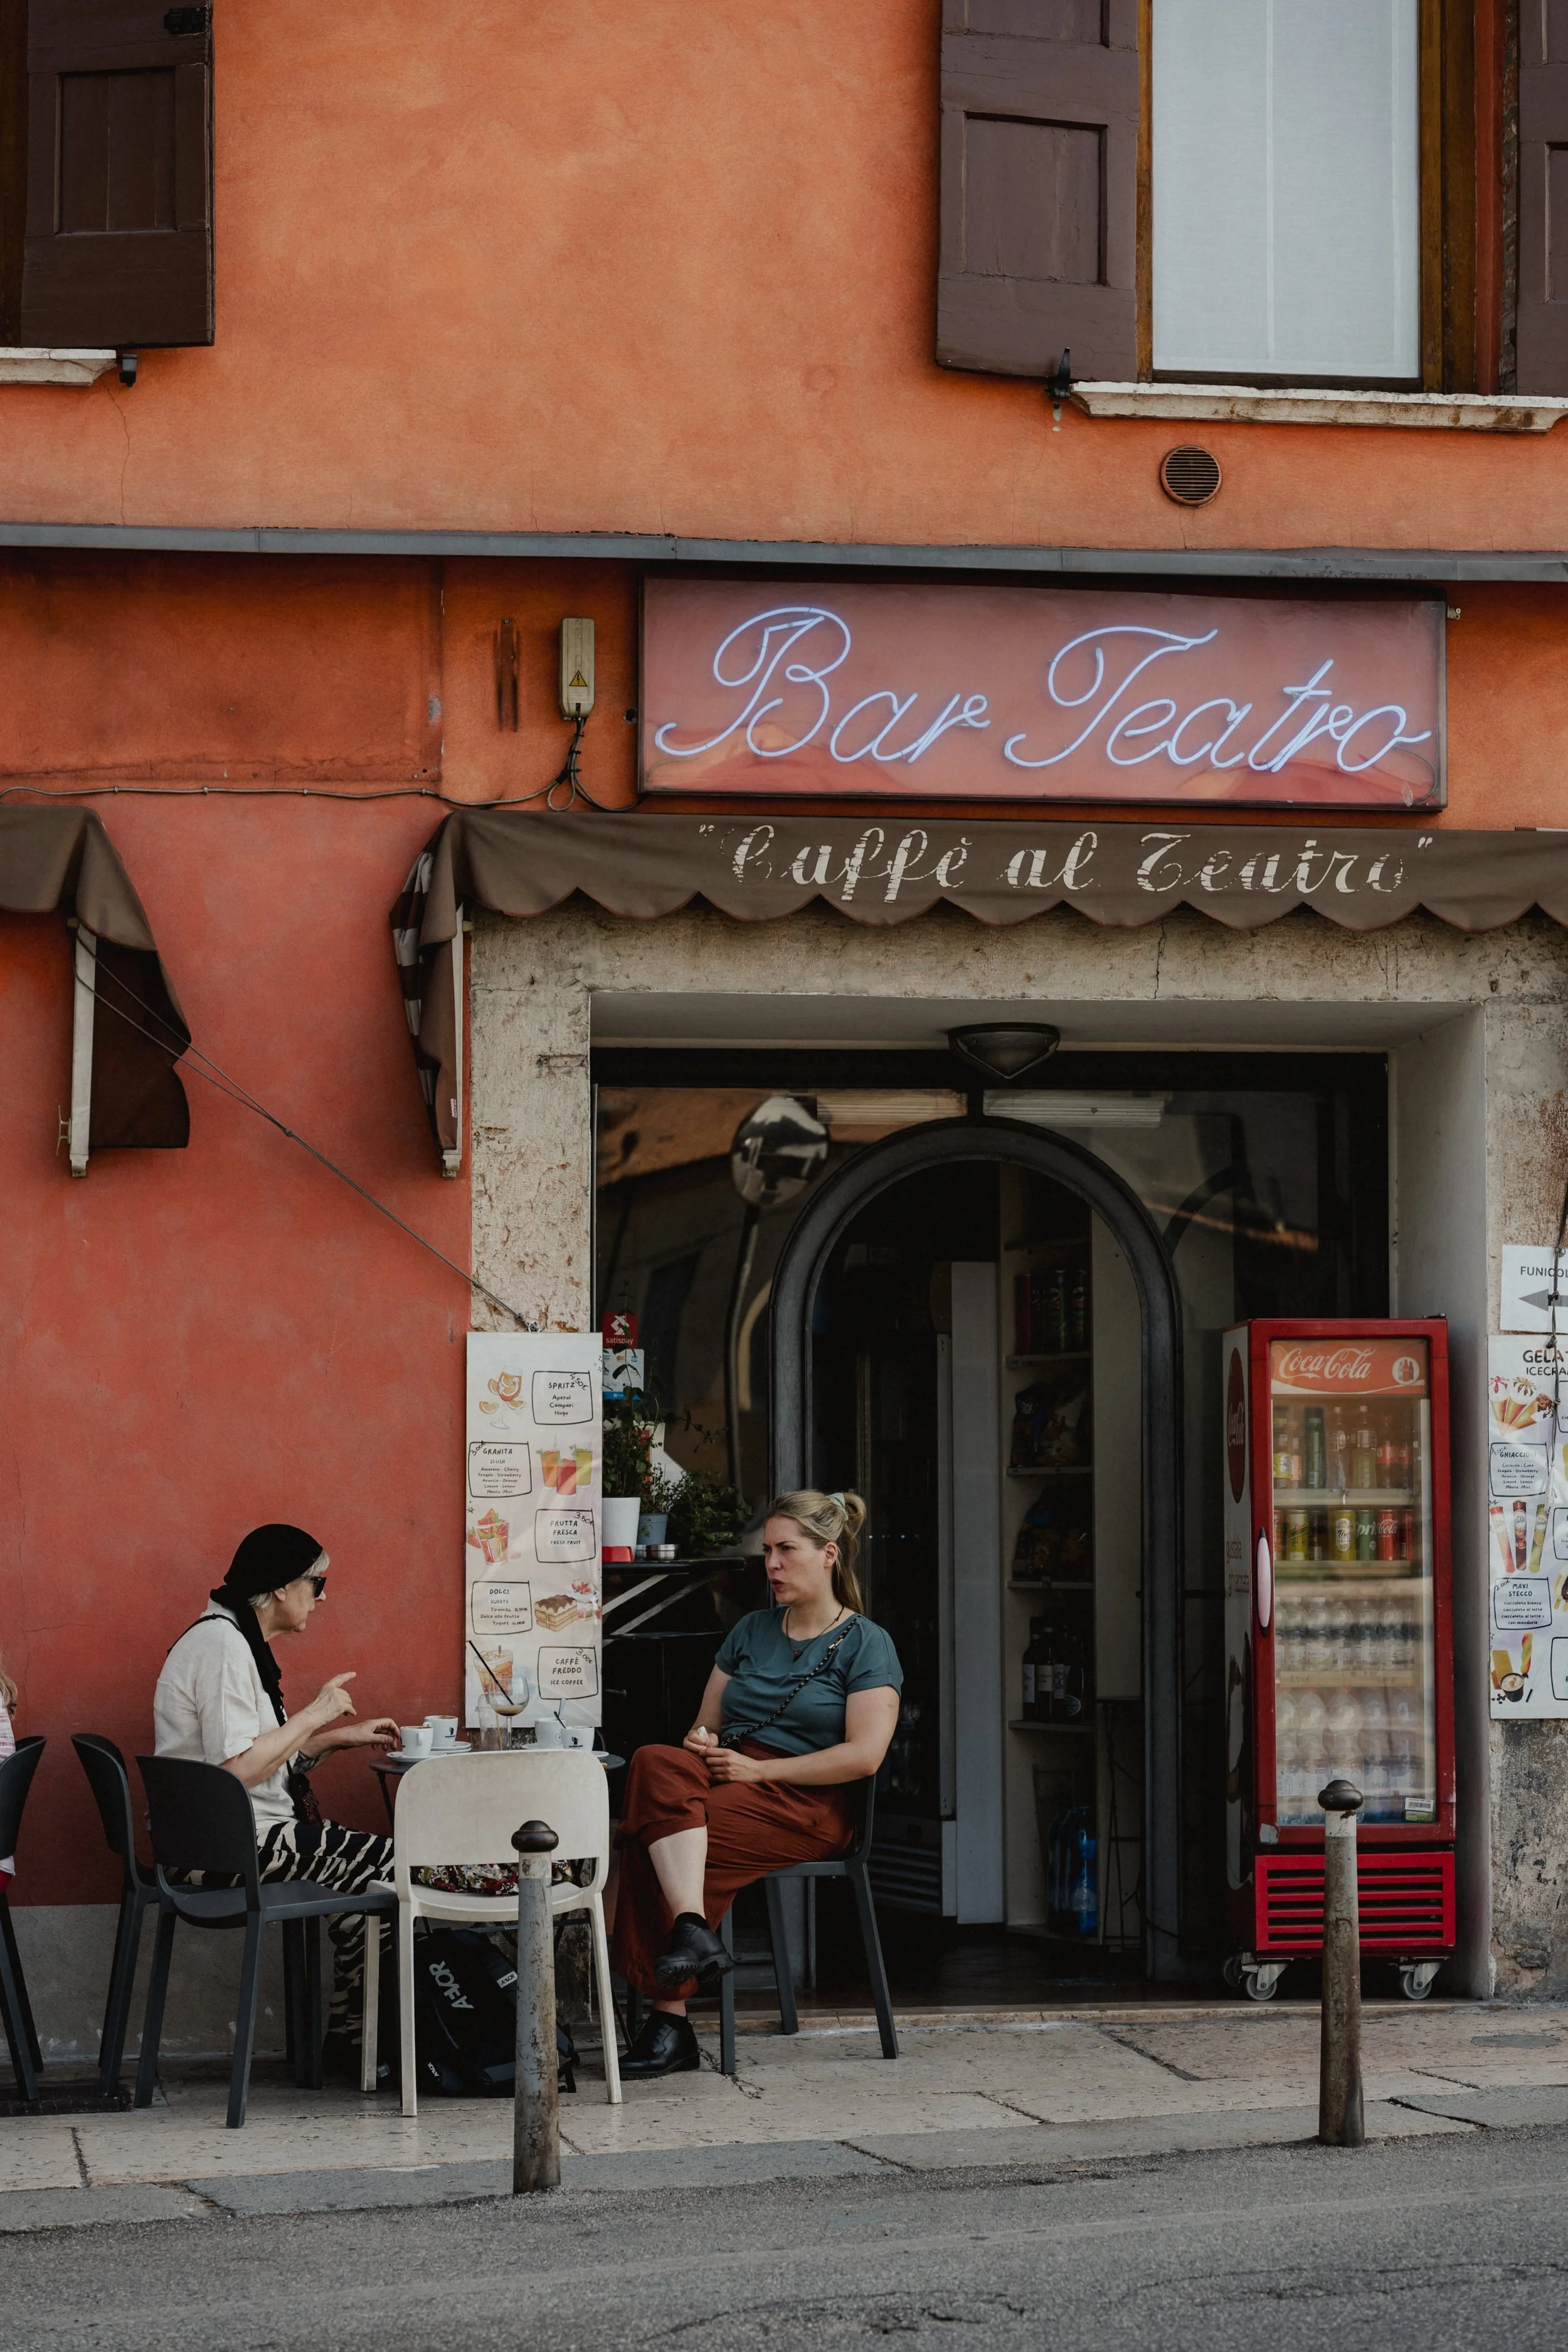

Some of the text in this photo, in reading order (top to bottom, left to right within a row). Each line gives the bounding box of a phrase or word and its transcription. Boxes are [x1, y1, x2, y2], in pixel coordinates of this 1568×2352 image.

[655, 606, 1433, 773] Bar Teatro
[1000, 831, 1100, 891] al
[605, 1337, 634, 1345] satispay
[1279, 1347, 1376, 1379] Coca-Cola
[1526, 1366, 1568, 1376] ICECRA
[548, 1382, 575, 1390] SPRITZ
[555, 1656, 580, 1665] CAFFÈ
